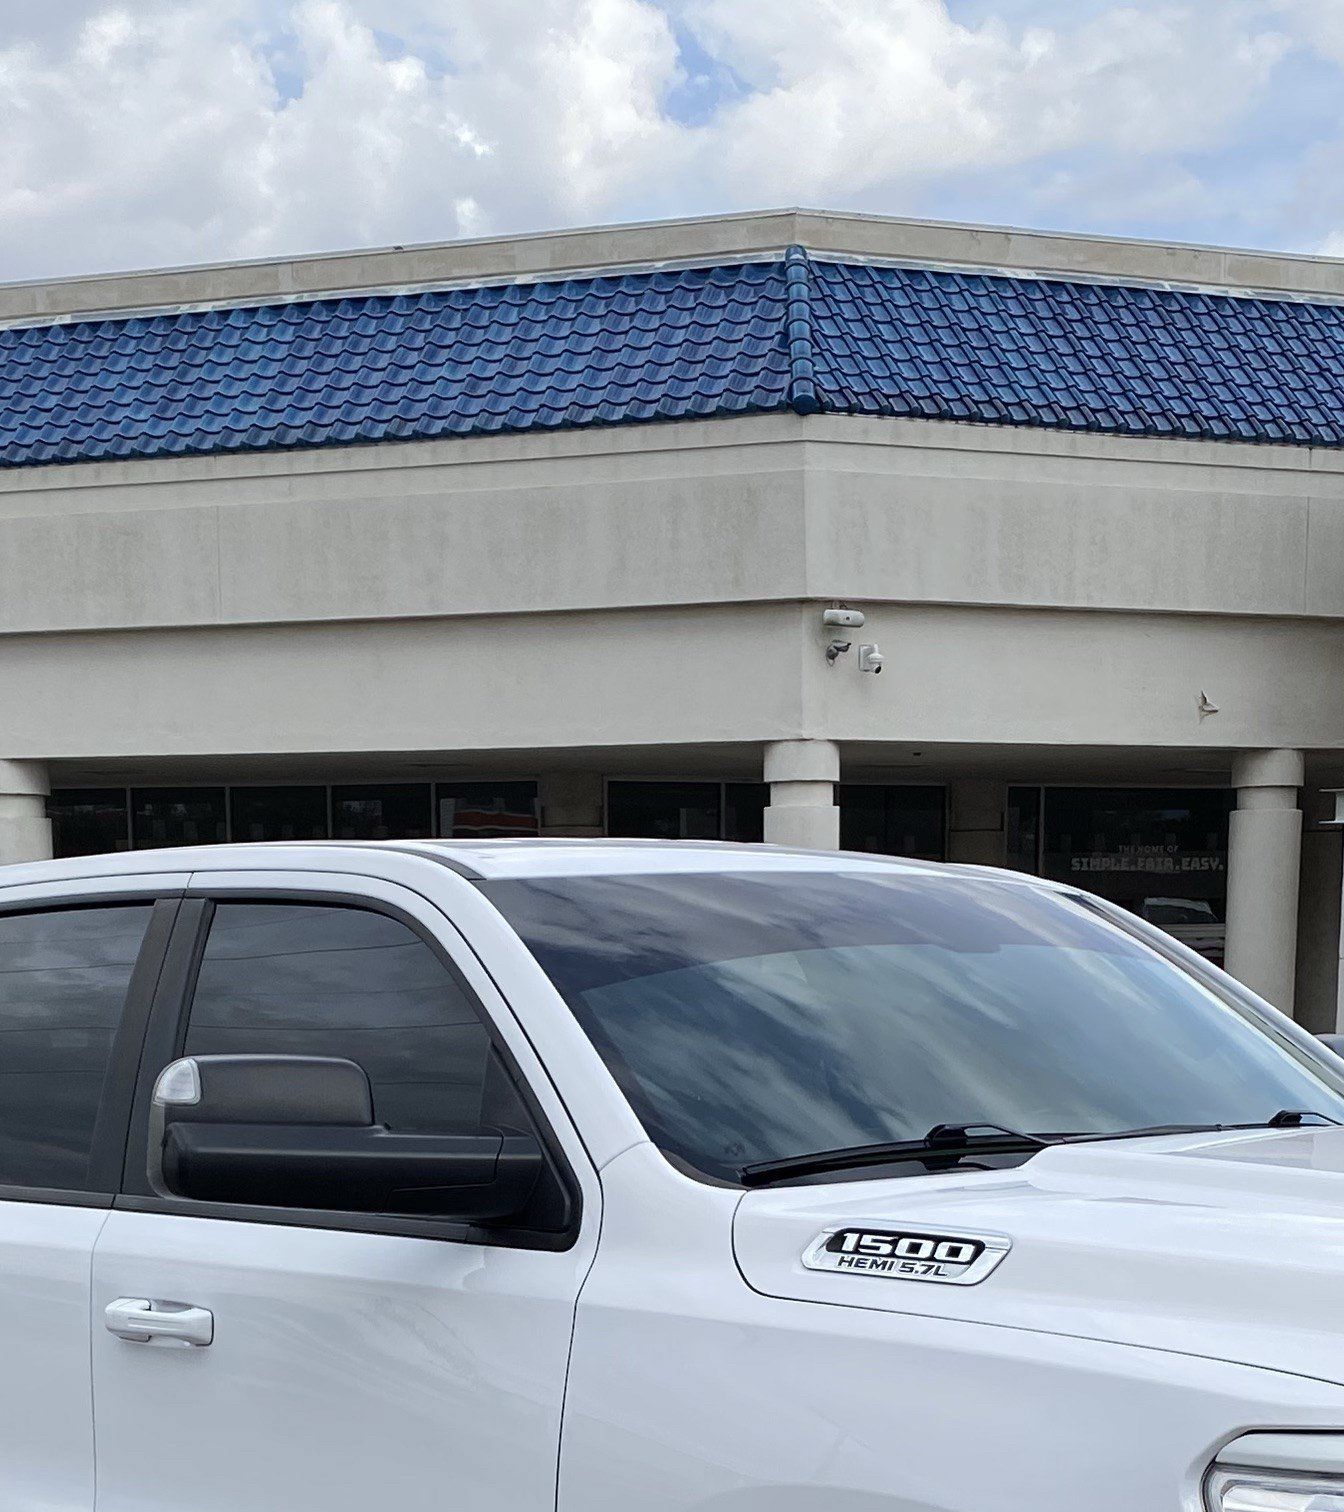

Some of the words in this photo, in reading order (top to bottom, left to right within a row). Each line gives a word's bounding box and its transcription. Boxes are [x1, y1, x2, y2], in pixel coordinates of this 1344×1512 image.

[841, 1232, 976, 1263] 1500
[837, 1255, 895, 1272] HEMI
[899, 1262, 949, 1278] 5.7L
